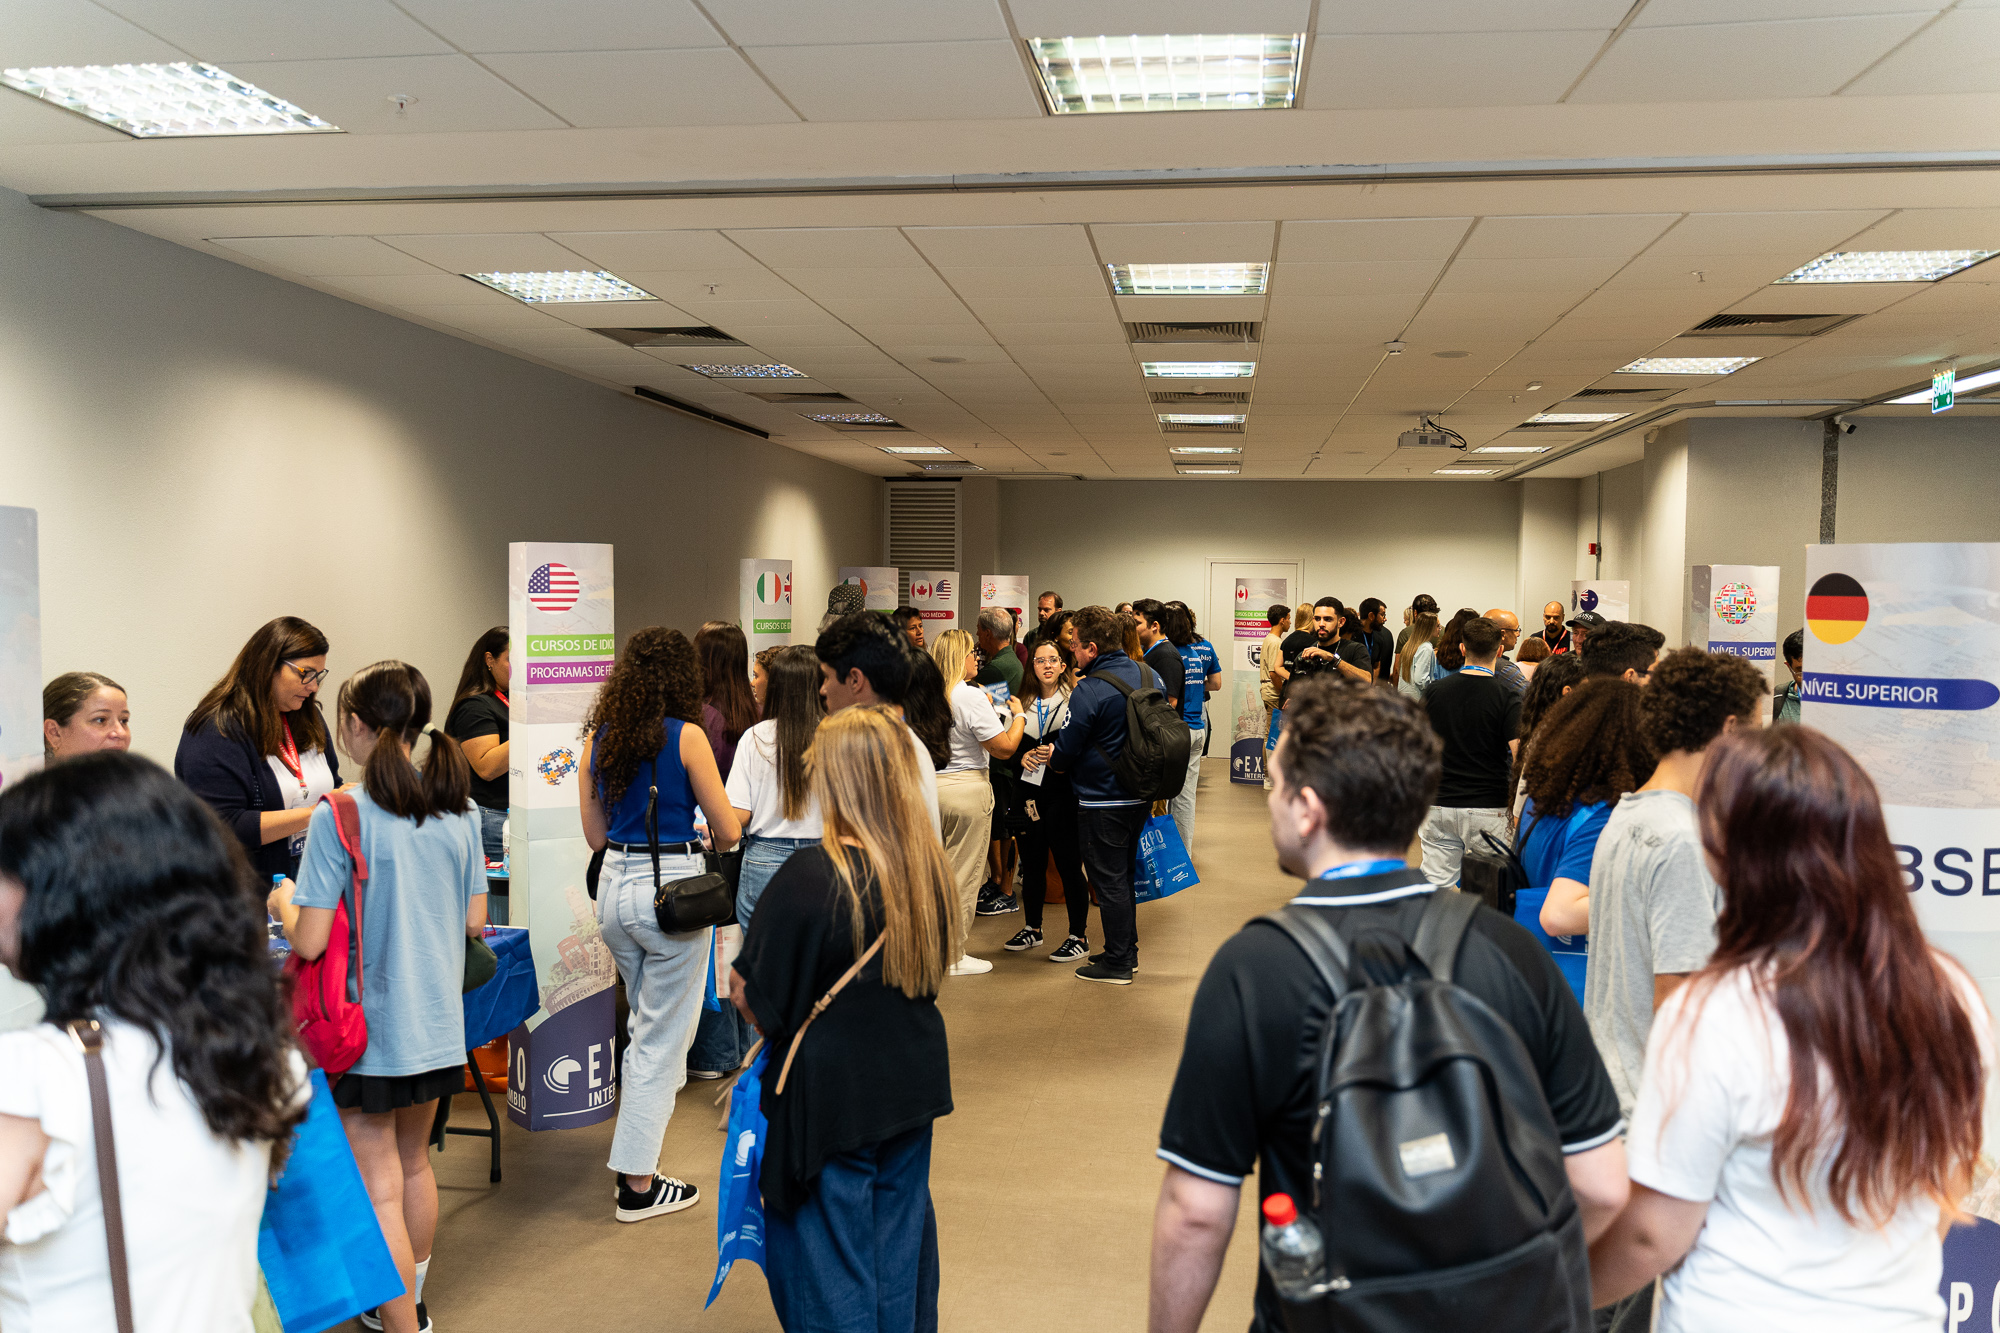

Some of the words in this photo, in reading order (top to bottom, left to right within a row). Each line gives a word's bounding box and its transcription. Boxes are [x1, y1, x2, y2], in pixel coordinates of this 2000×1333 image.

[756, 622, 779, 630] CURSOS
[780, 622, 787, 630] DE
[531, 639, 580, 651] CURSOS
[583, 639, 597, 651] DE
[599, 638, 614, 650] IDIO
[1711, 644, 1739, 656] NÍVEL
[530, 665, 593, 678] PROGRAMAS
[594, 665, 605, 677] DE
[1802, 678, 1842, 698] NÍVEL
[1845, 683, 1938, 703] SUPERIOR
[1244, 755, 1262, 773] EX
[1140, 829, 1164, 852] EXPO
[588, 1036, 615, 1089] EX
[1949, 1279, 2000, 1333] P
